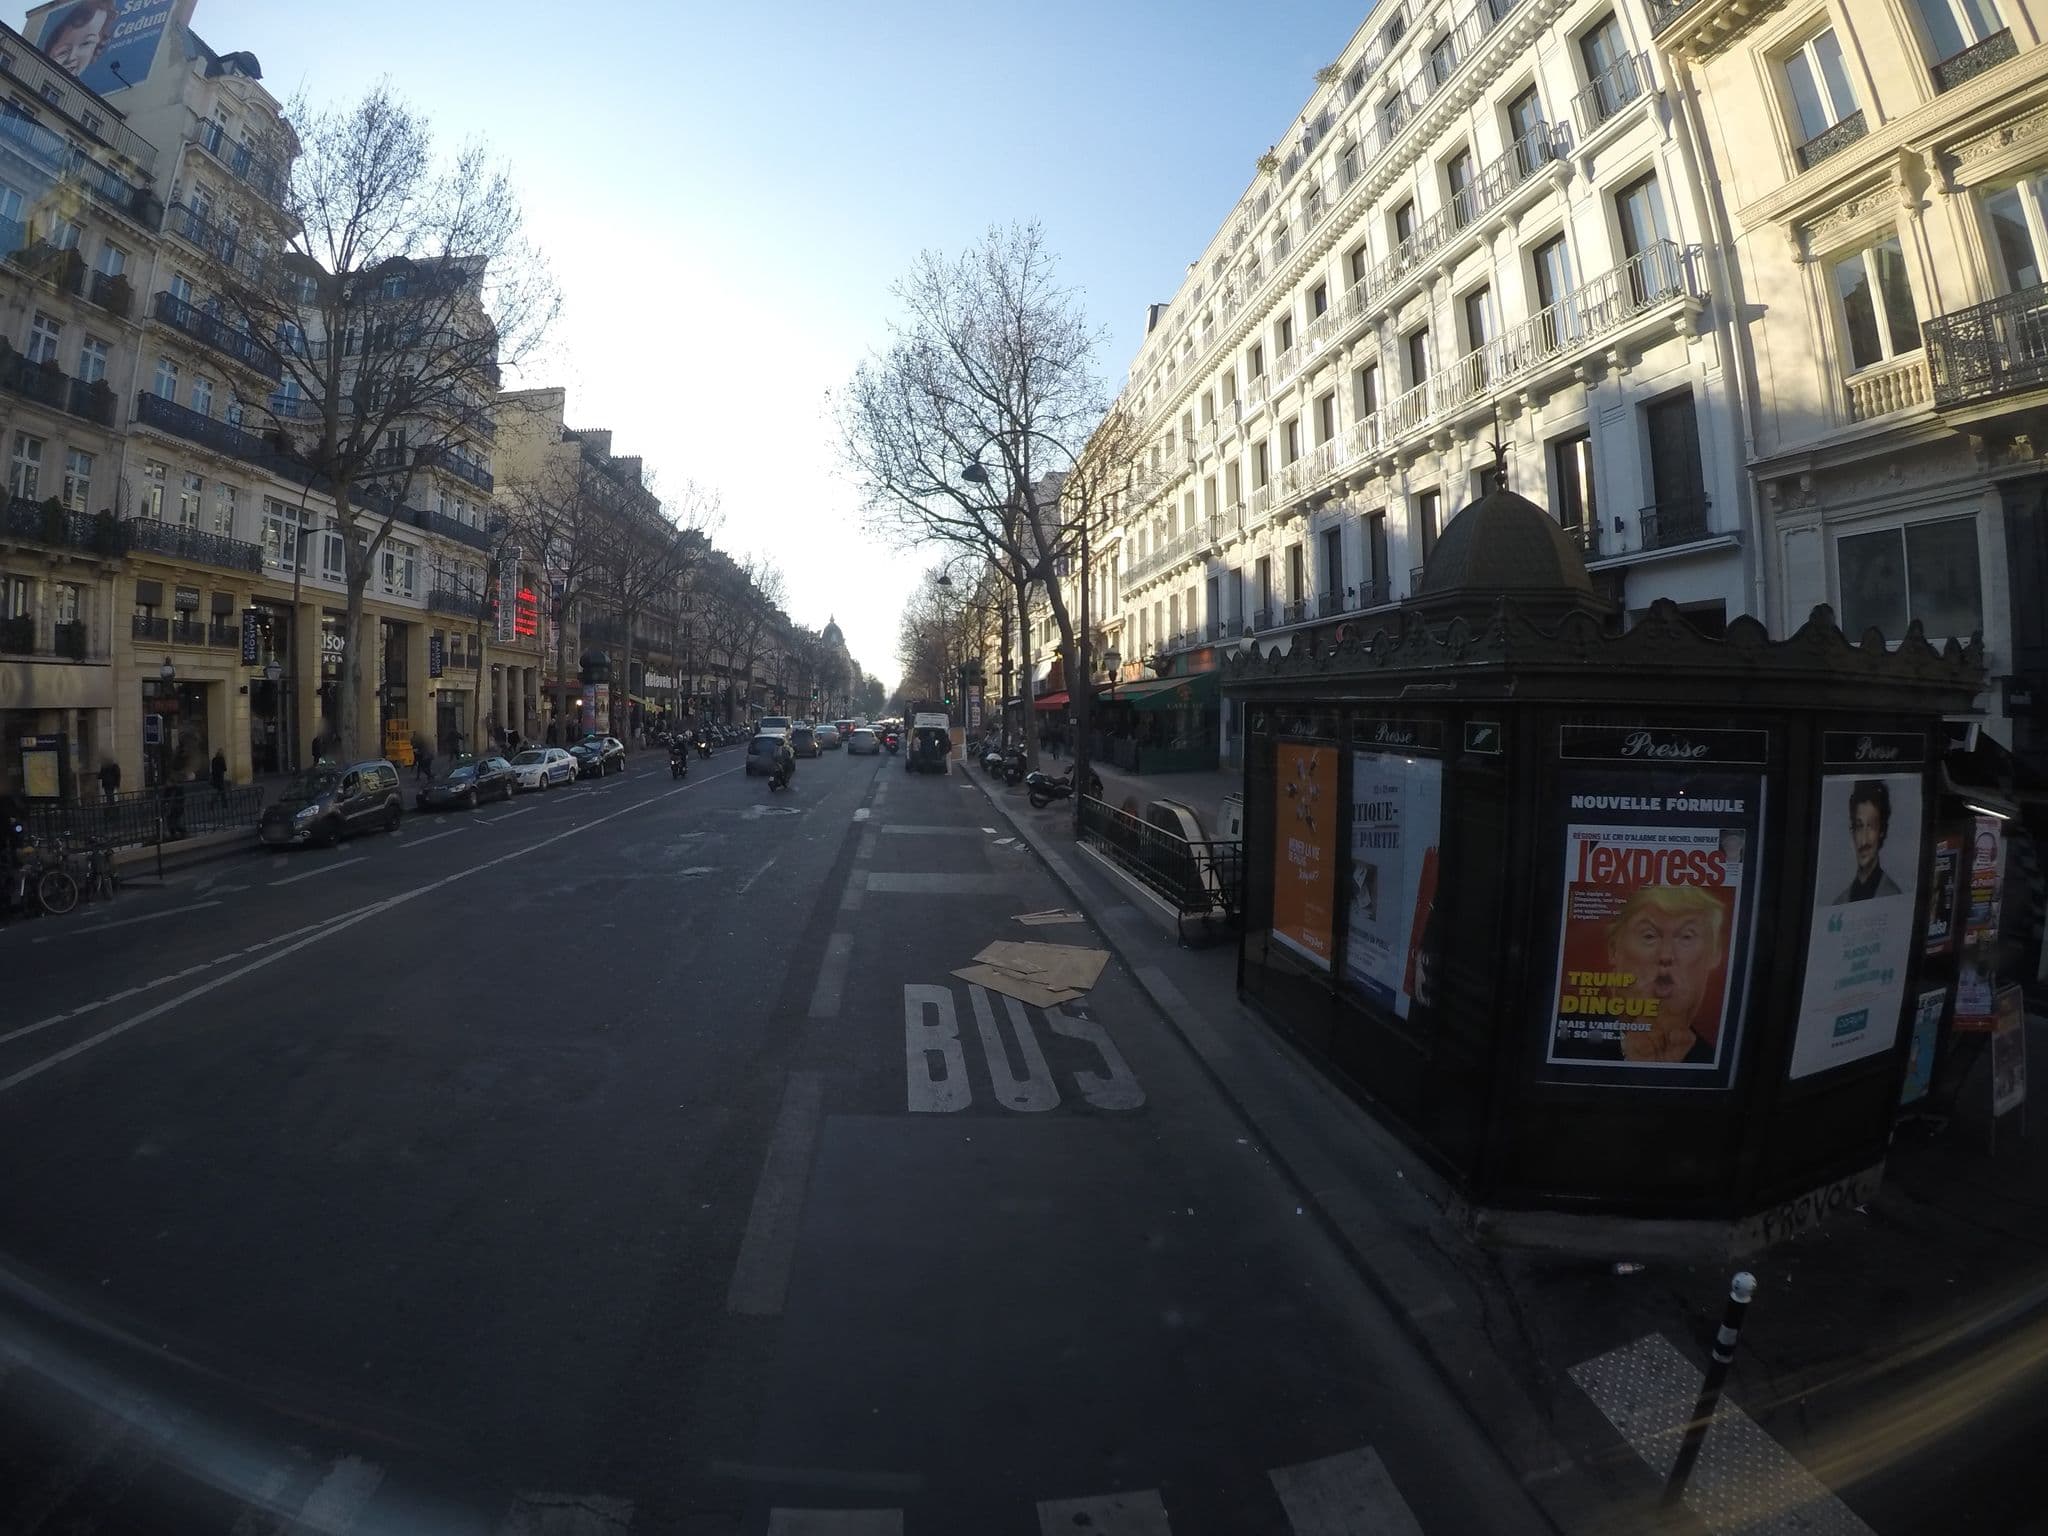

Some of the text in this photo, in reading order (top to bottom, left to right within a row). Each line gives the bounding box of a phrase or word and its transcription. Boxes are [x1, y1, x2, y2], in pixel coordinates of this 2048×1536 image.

[113, 11, 168, 38] Cadum
[1375, 721, 1415, 744] Presse
[1620, 731, 1710, 758] Presse
[1854, 736, 1899, 761] Presse
[1571, 794, 1745, 813] NOUVELLE FORMULE
[1360, 832, 1399, 848] PARTIE
[1567, 971, 1636, 987] TRUMP
[1579, 987, 1600, 996] EST
[1560, 995, 1660, 1017] DINGUE
[1588, 1020, 1652, 1032] L'AMÉRIQUE
[904, 983, 1146, 1113] BUS
